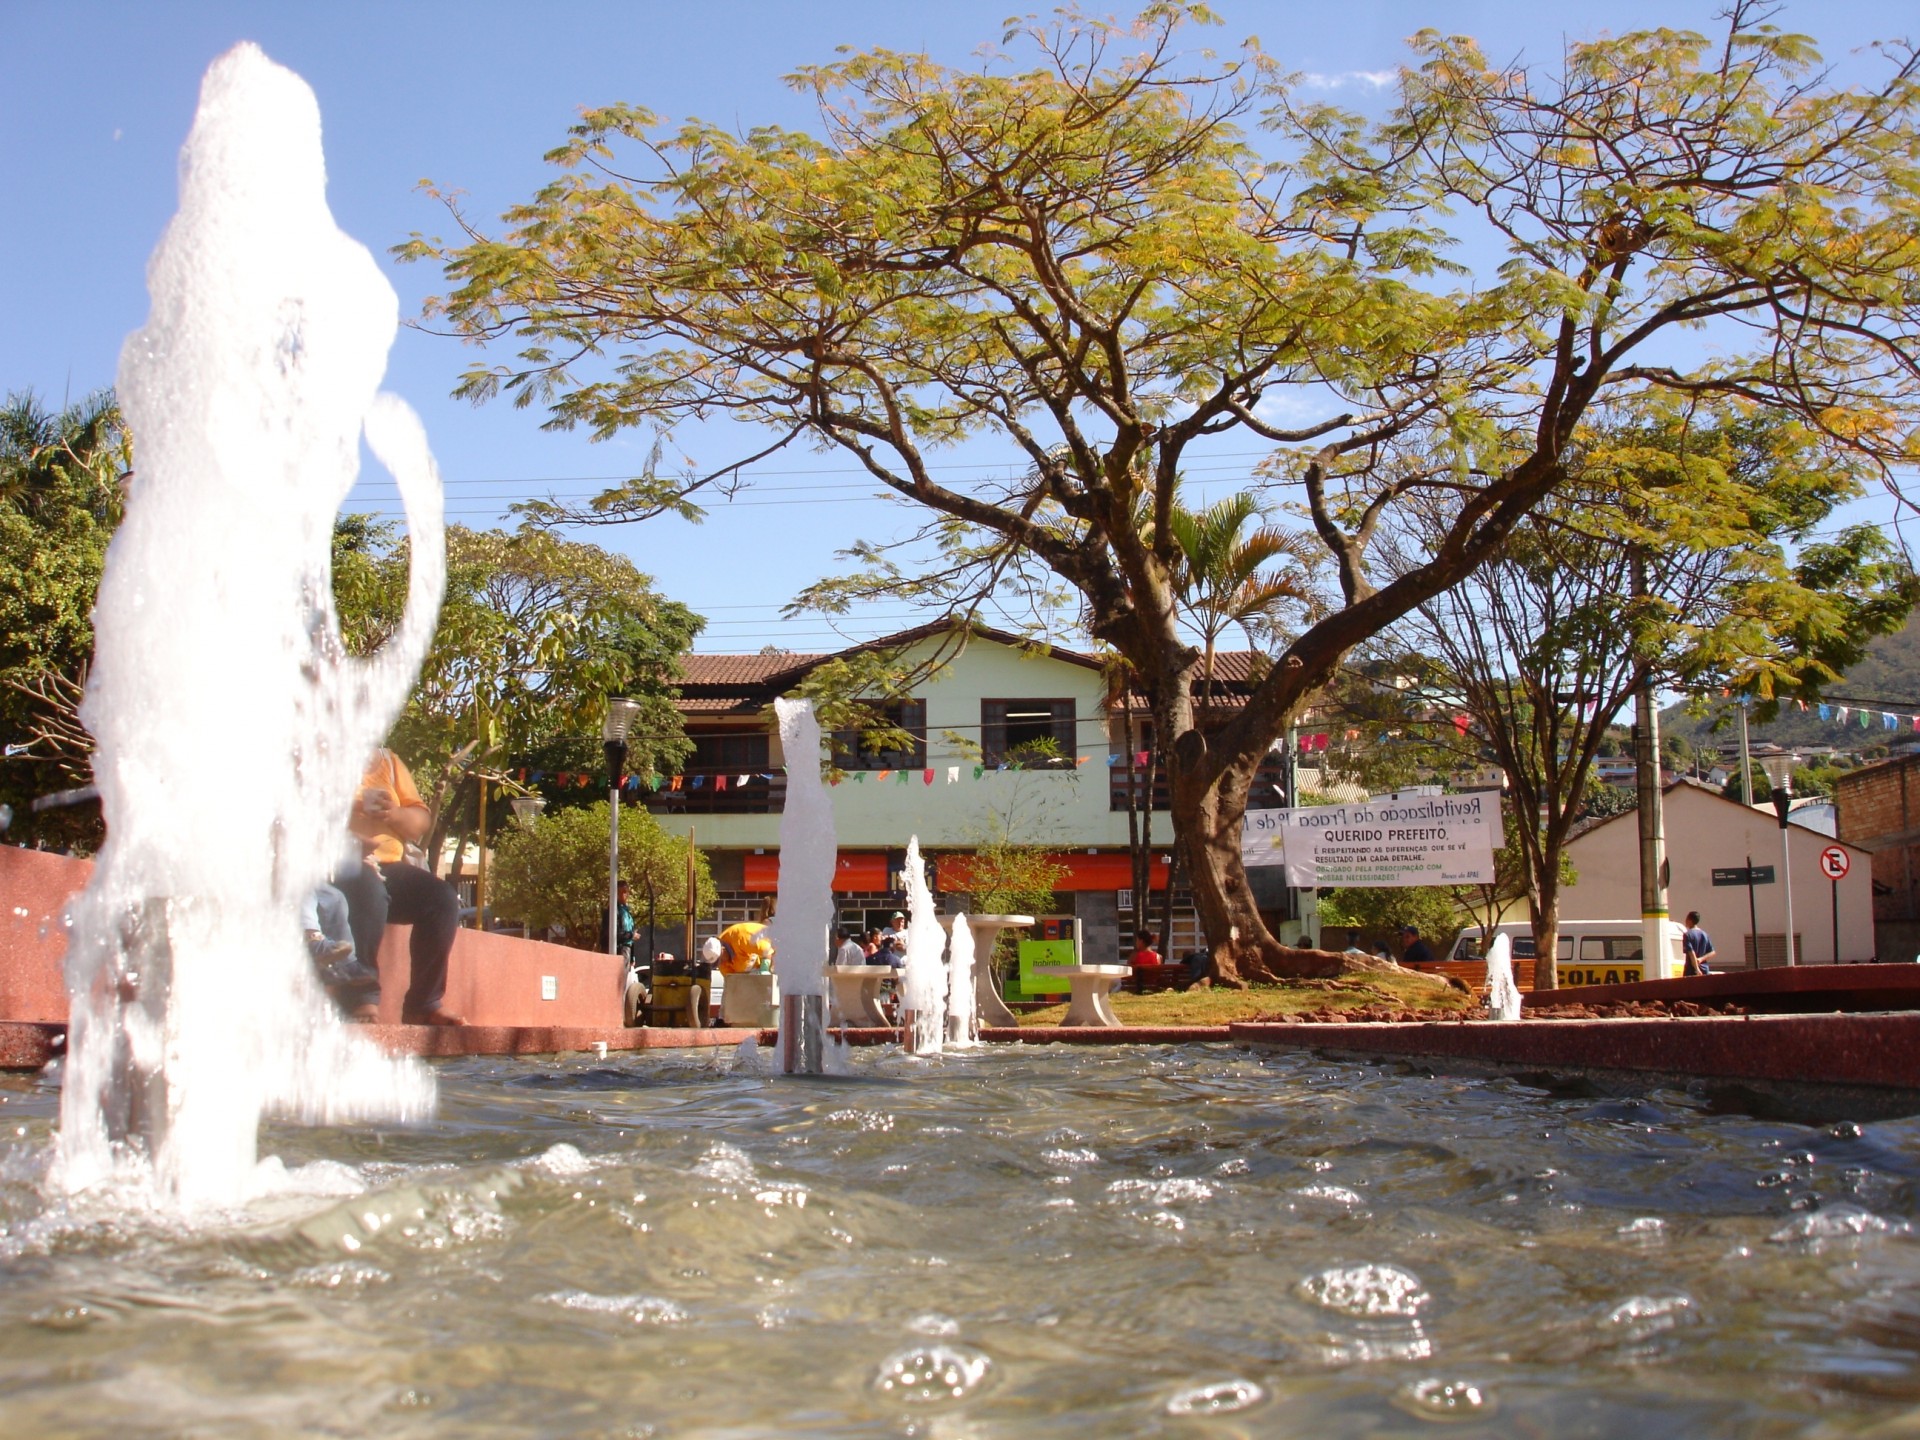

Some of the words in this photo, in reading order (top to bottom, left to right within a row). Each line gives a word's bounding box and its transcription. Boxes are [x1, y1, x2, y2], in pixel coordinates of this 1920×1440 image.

[1324, 830, 1383, 843] QUERIDO
[1388, 828, 1449, 841] PREFEITO,
[1322, 847, 1371, 855] RESPEITANDO
[1385, 845, 1428, 853] DIFERENÇAS
[1315, 855, 1354, 863] RESULTADO
[1370, 855, 1389, 863] CADA
[1391, 854, 1425, 862] DETALHE.
[1375, 864, 1424, 873] PREOCUPAÇÃO
[1426, 863, 1442, 871] COM
[1317, 874, 1344, 882] NOSSAS
[1557, 970, 1641, 986] COLAR
